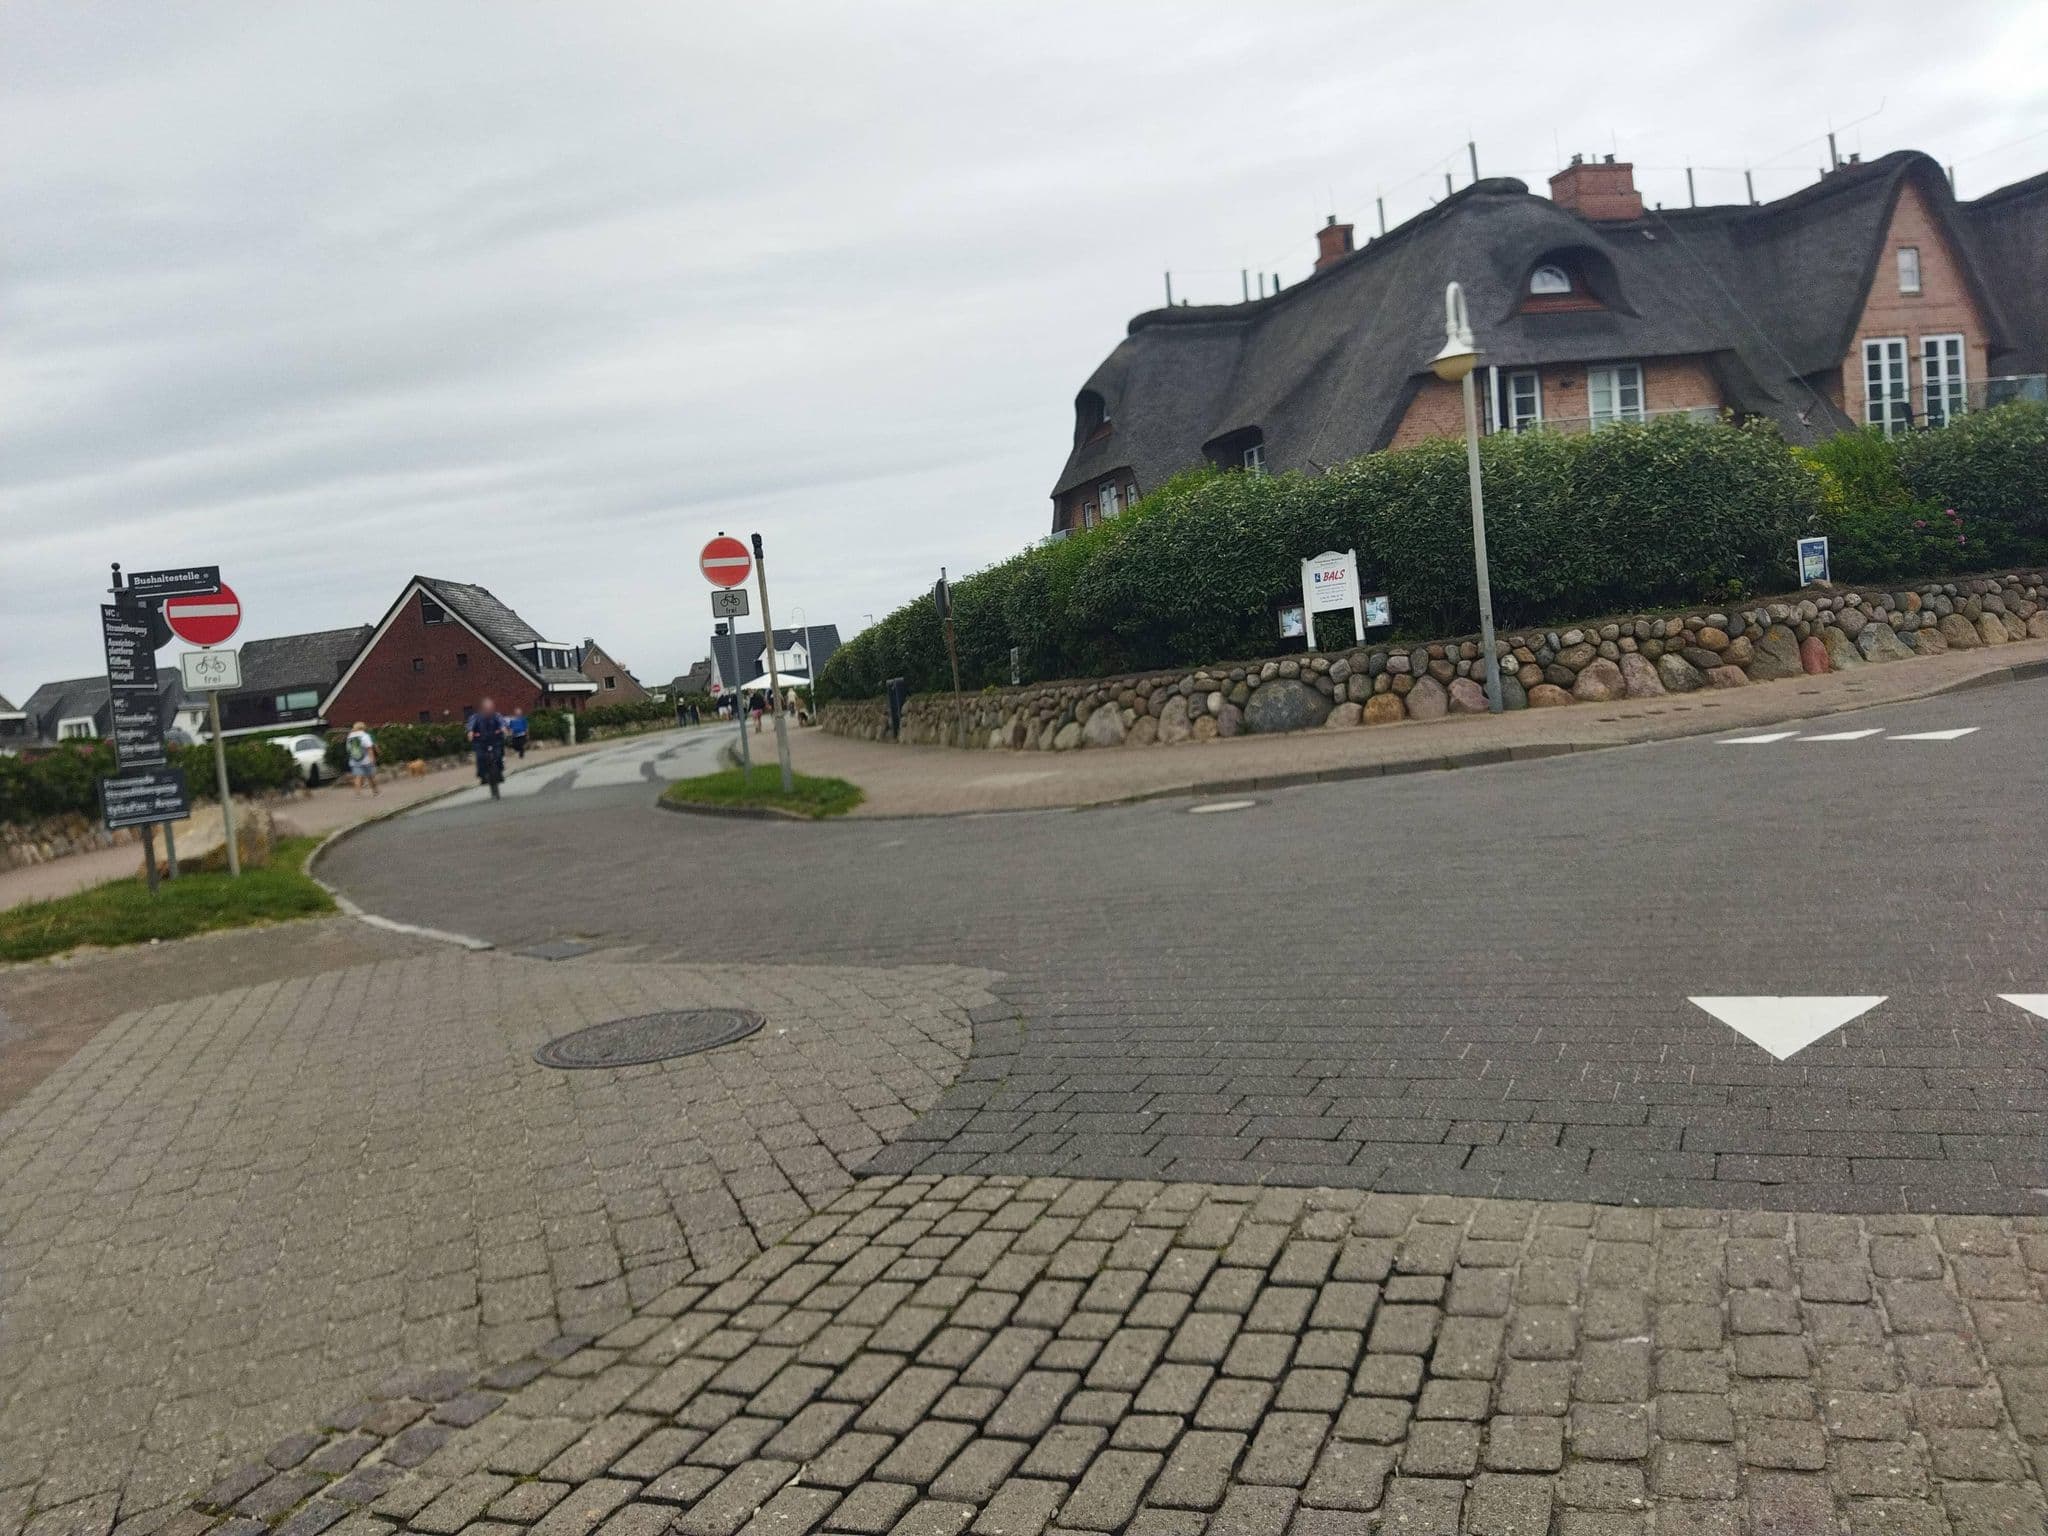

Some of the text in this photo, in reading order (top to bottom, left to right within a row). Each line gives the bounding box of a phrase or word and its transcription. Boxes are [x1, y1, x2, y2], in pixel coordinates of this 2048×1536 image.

[134, 572, 200, 585] Bushaltestelle
[1323, 569, 1346, 581] BALS
[104, 608, 116, 617] WC
[204, 674, 221, 684] frei
